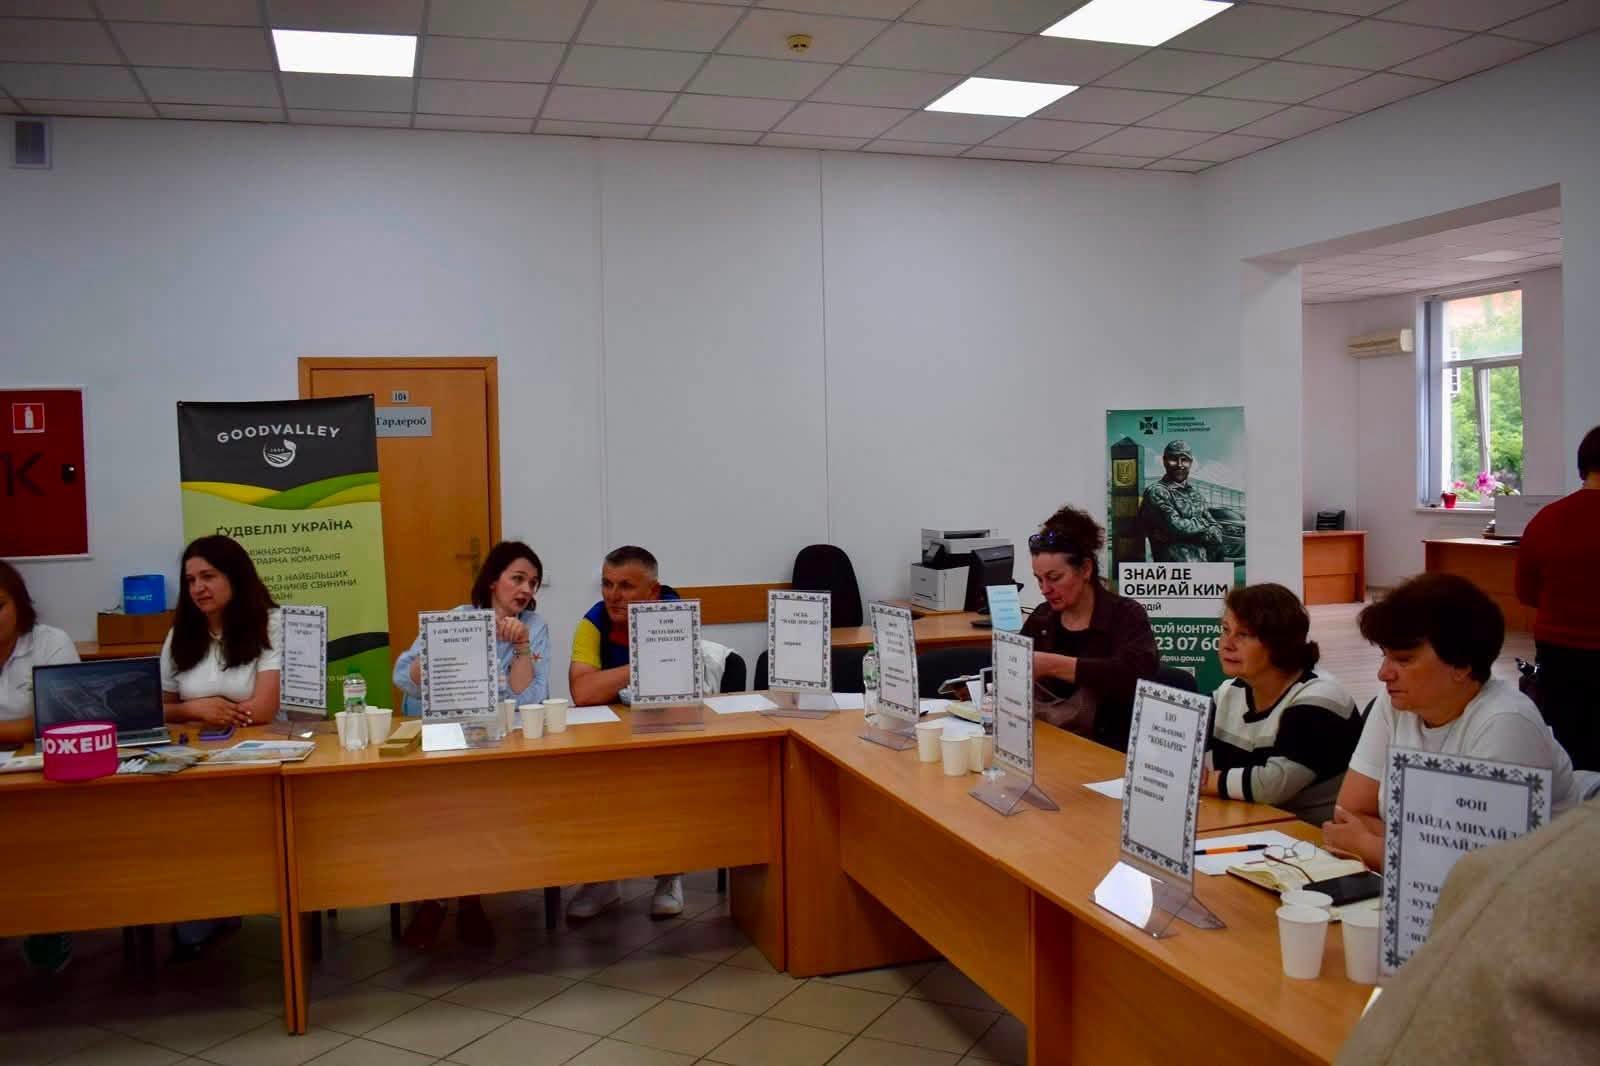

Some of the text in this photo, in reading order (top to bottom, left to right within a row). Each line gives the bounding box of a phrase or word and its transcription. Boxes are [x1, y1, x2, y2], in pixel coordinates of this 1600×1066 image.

[217, 423, 341, 444] GOODVALLEY
[292, 519, 353, 534] УКРАЇНА
[291, 553, 341, 563] КОМПАНІЯ
[285, 569, 348, 581] НАЙБІЛЬШИХ
[1124, 566, 1193, 580] ЗНАЙ ДЕ
[310, 579, 357, 589] СВИНИНИ
[1124, 581, 1228, 596] ОБИРАЙ КИМ
[1176, 636, 1198, 650] 07
[1455, 797, 1488, 812] ФОП
[1407, 812, 1452, 830] НАЙДА
